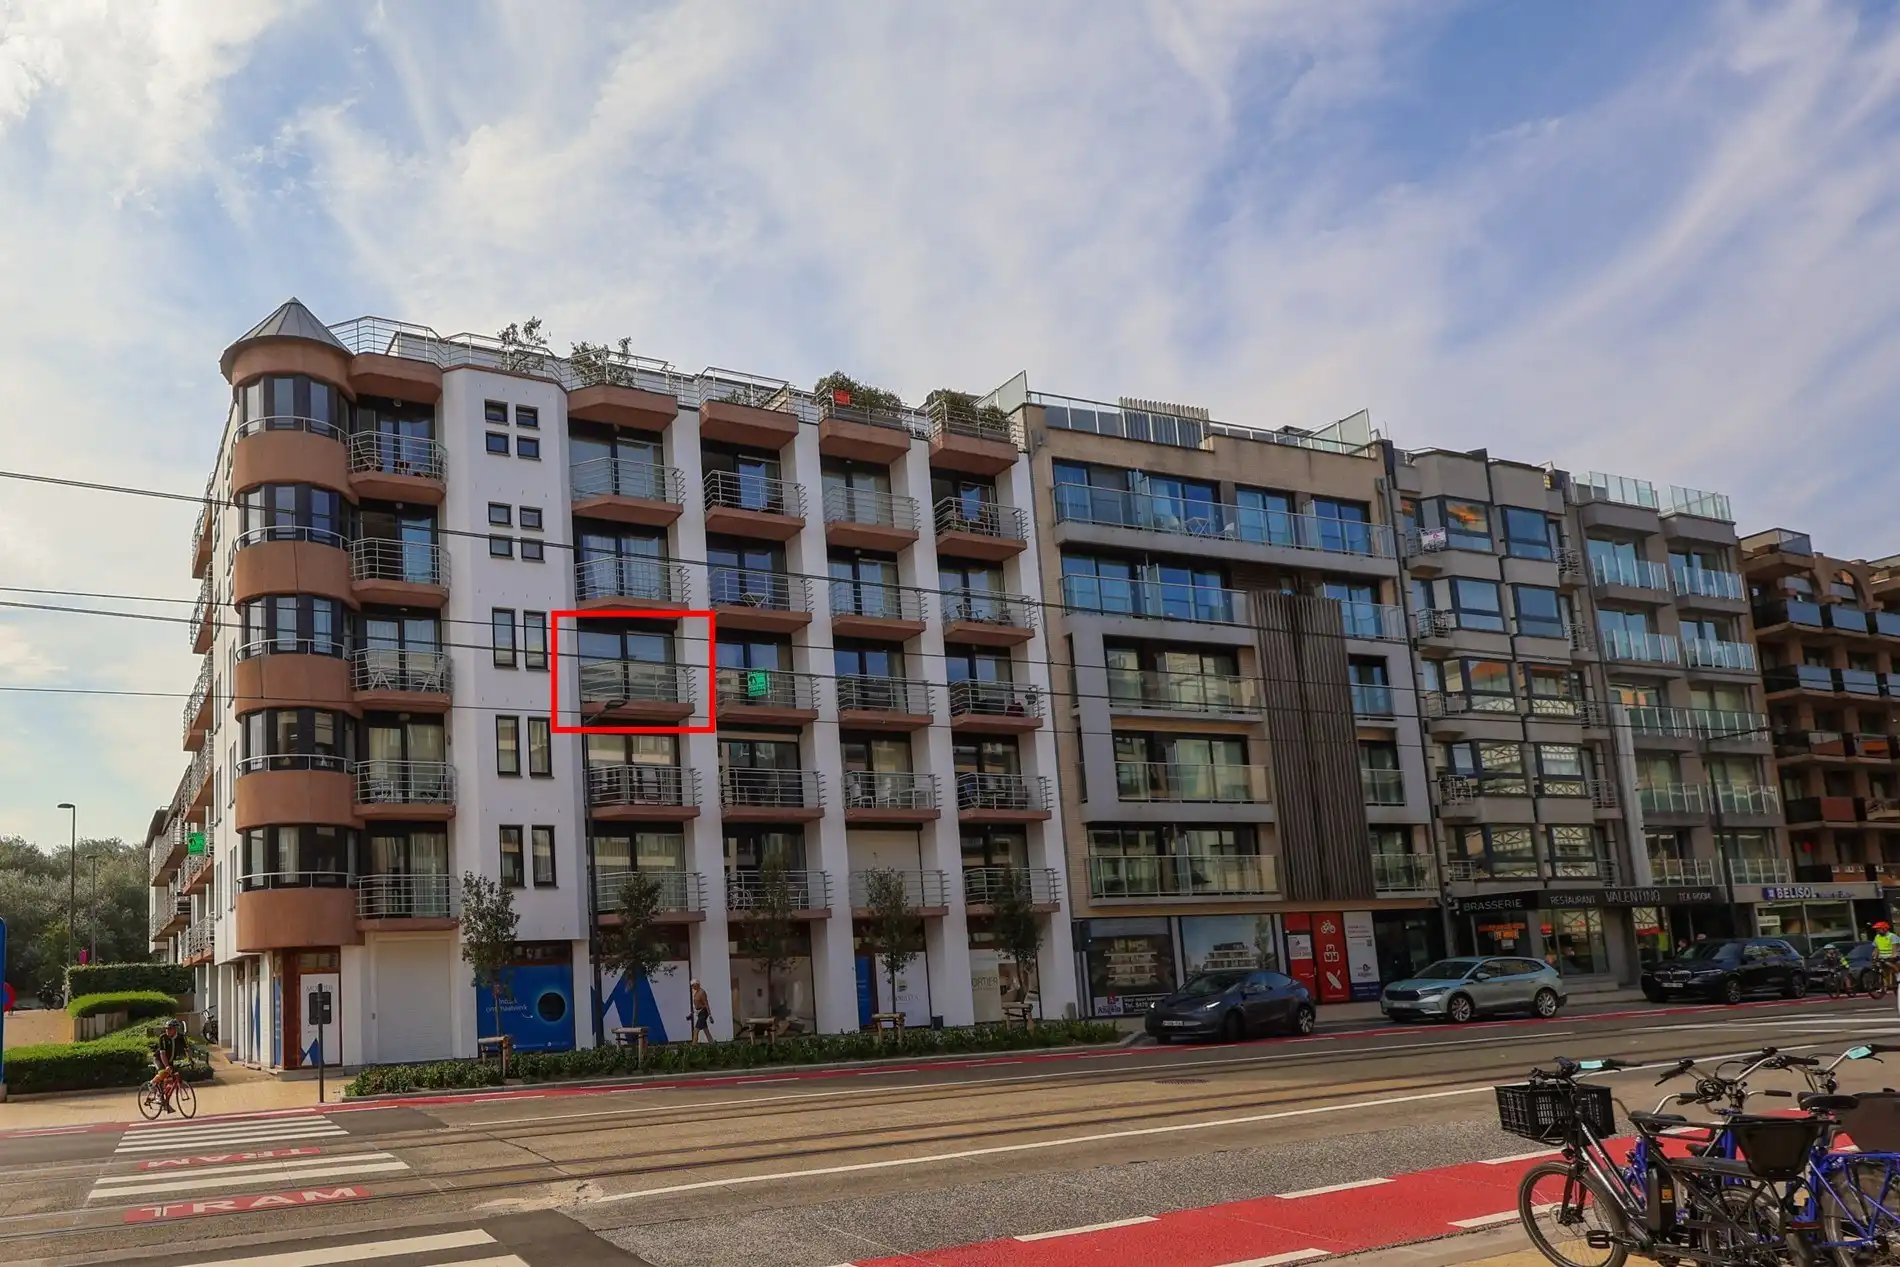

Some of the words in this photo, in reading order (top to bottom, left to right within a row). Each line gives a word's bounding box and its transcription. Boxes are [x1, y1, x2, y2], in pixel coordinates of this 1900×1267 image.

[1463, 899, 1523, 911] BRASSERIE
[1550, 895, 1596, 905] RESTAURANT
[1605, 889, 1660, 903] VALENTINO
[1776, 887, 1817, 898] BELISOL
[971, 976, 998, 988] ORTIER
[147, 1147, 314, 1169] TRAM
[140, 1187, 358, 1217] TRAM
